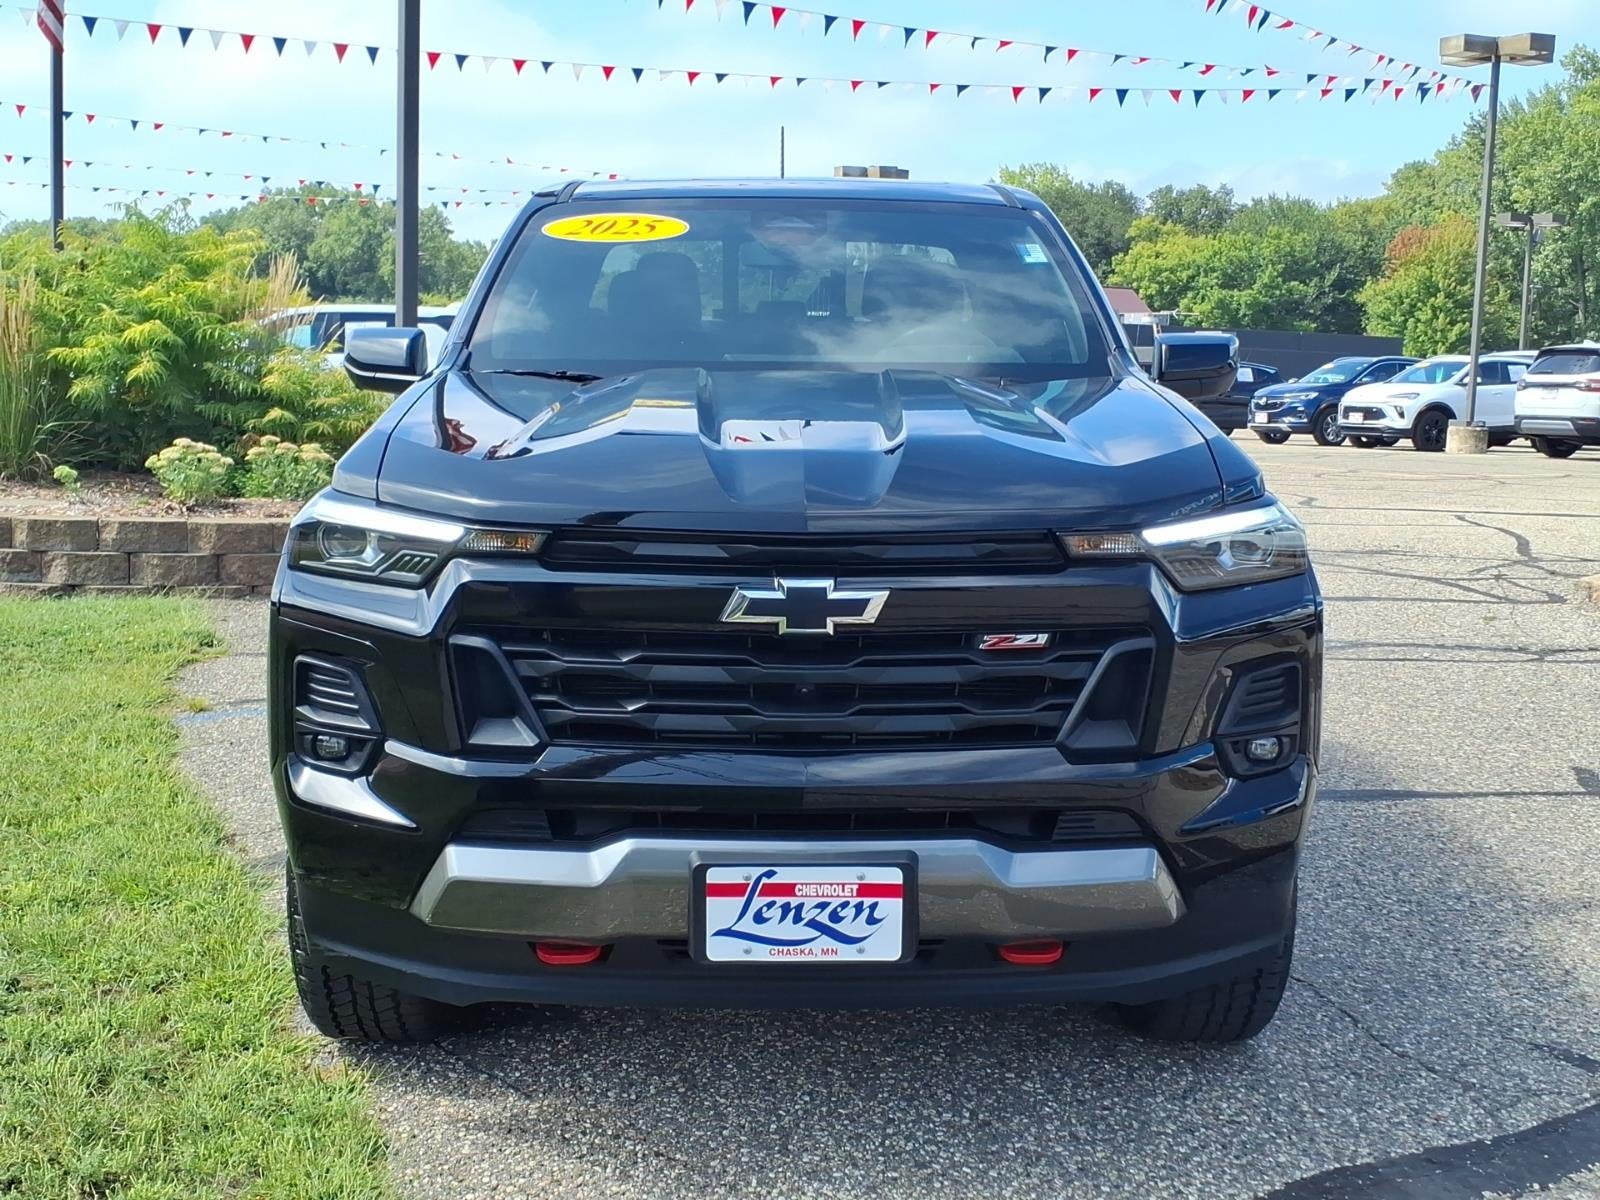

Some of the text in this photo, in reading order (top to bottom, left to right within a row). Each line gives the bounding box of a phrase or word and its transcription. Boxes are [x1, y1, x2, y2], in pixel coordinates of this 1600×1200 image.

[564, 219, 665, 236] 2025
[979, 633, 1049, 650] Z71
[794, 884, 859, 897] CHEVROLET
[710, 869, 889, 947] Lenzen
[768, 947, 839, 958] CHASKA, MN
